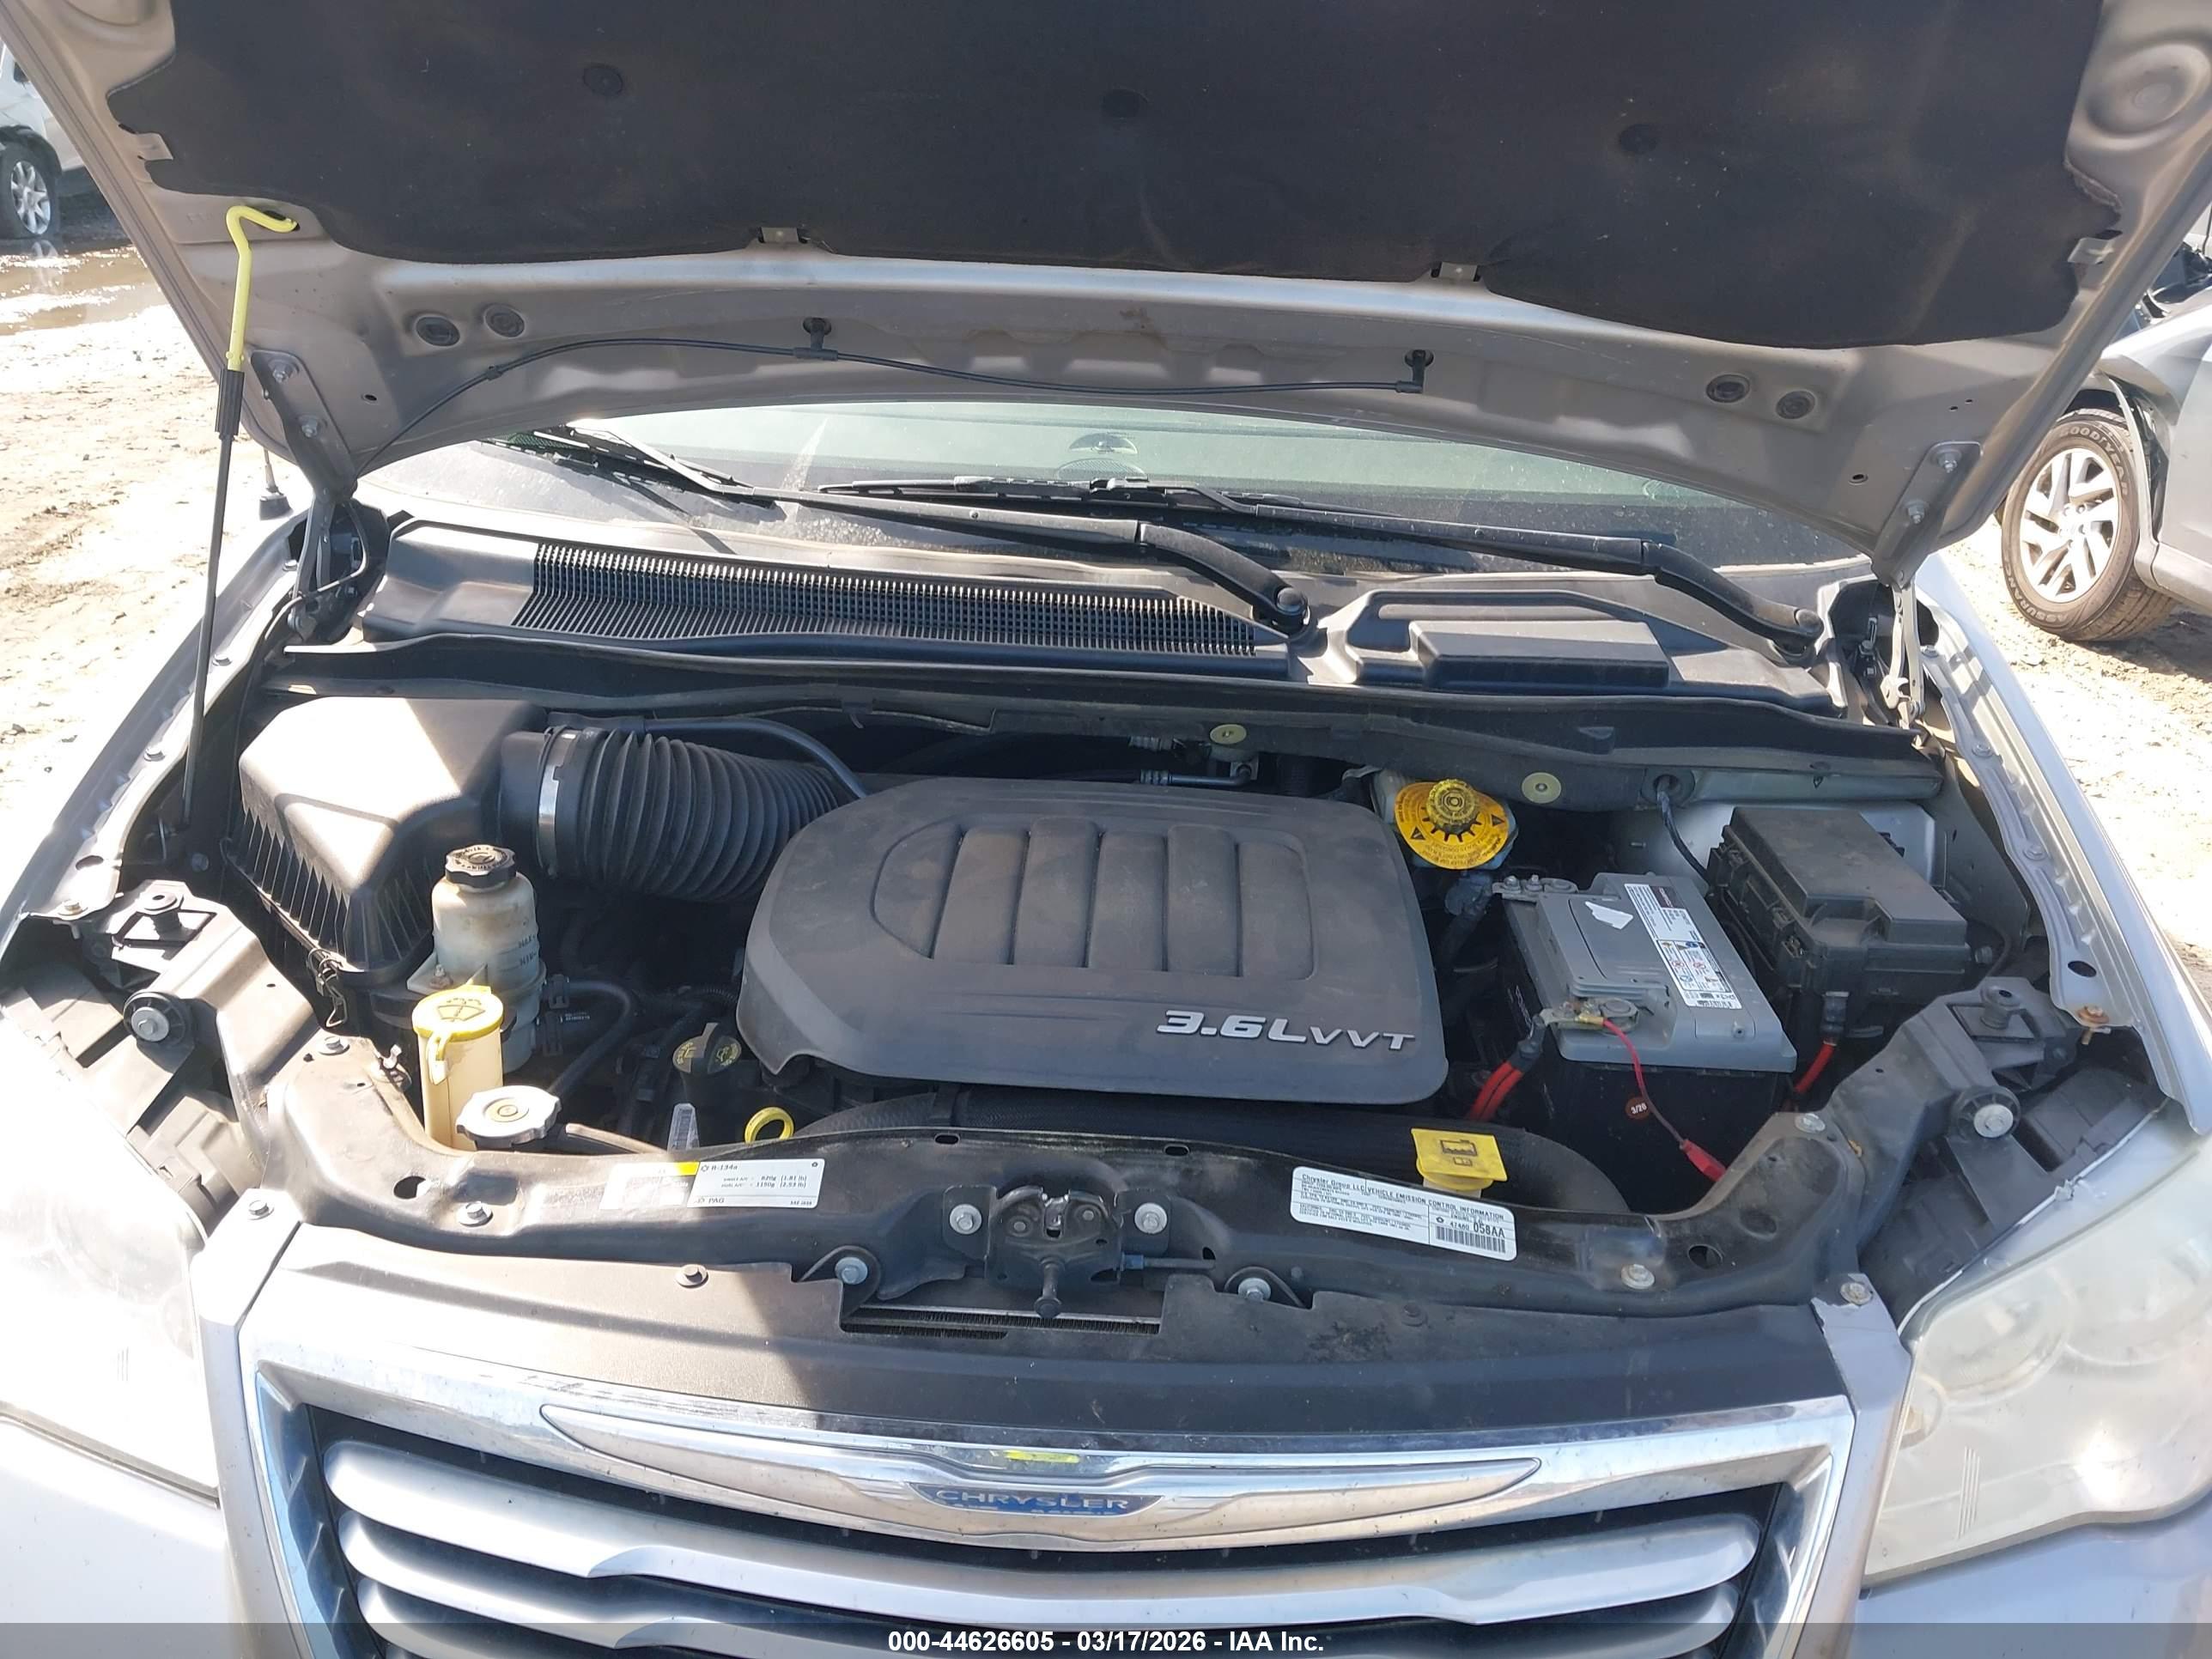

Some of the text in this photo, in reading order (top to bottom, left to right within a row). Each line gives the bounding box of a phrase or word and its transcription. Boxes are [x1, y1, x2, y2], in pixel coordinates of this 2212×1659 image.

[1302, 1173, 1329, 1186] Chrysler
[1330, 1179, 1351, 1190] Group
[1352, 1183, 1365, 1192] LLC
[1367, 1187, 1394, 1198] VEHICLE
[1395, 1192, 1426, 1204] EMISSION
[1428, 1199, 1457, 1211] CONTROL
[1459, 1206, 1505, 1219] INFORMATION
[1473, 1221, 1506, 1239] 058AA
[936, 1489, 1129, 1510] CHRYSLER
